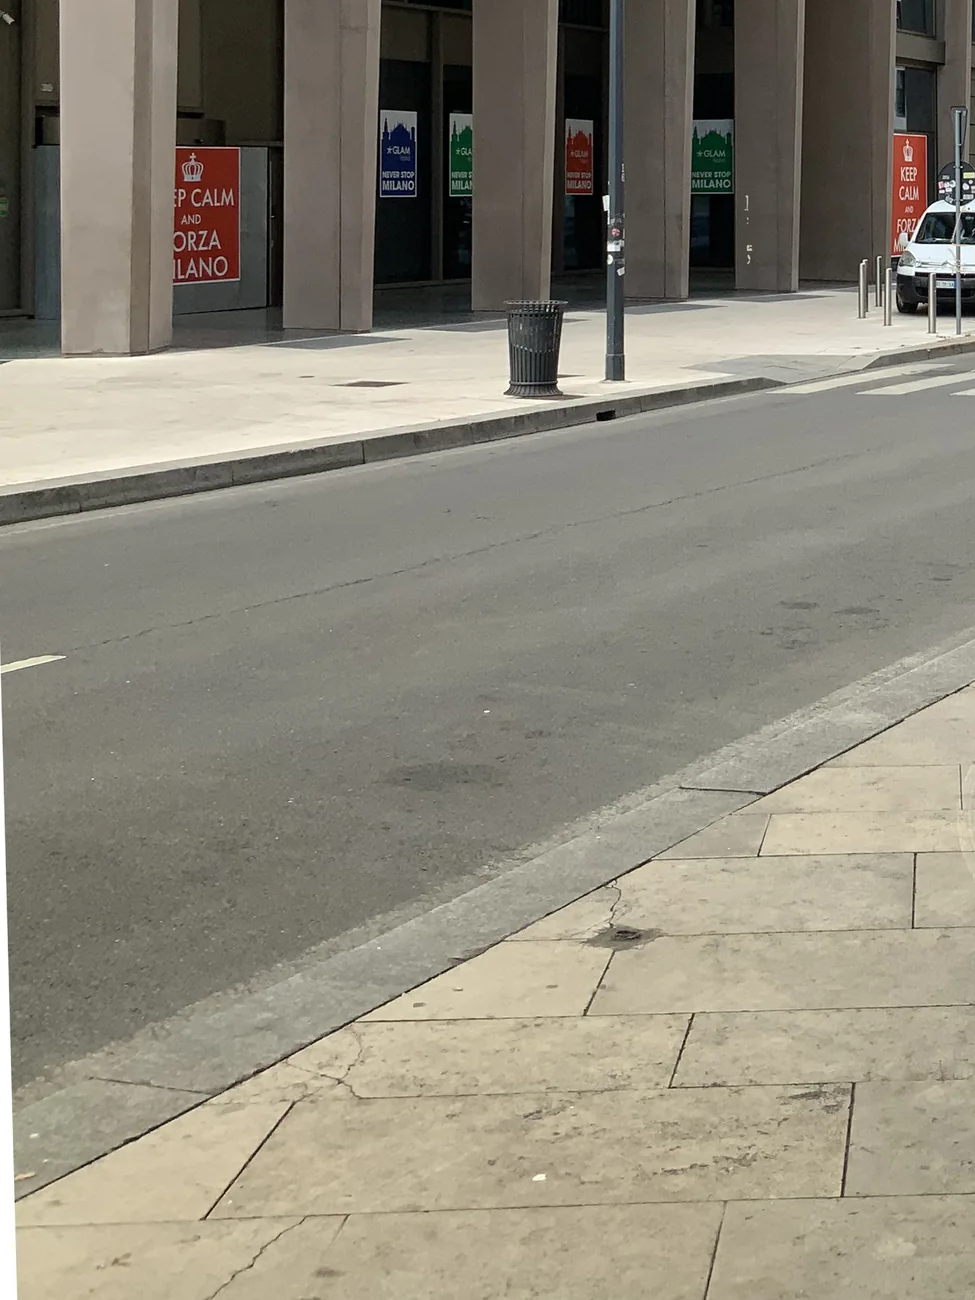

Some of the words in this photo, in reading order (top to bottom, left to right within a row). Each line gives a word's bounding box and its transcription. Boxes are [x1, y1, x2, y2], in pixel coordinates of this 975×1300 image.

[703, 149, 726, 158] GLAM
[400, 171, 415, 179] STOP
[900, 167, 917, 182] KEEP
[382, 180, 415, 191] MILANO
[567, 180, 592, 189] MILANO
[691, 179, 732, 189] MILANO
[191, 187, 235, 207] CALM
[899, 186, 919, 201] CALM
[904, 205, 914, 214] AND
[180, 214, 202, 225] AND
[173, 229, 221, 252] ORZA
[173, 256, 229, 280] ILANO
